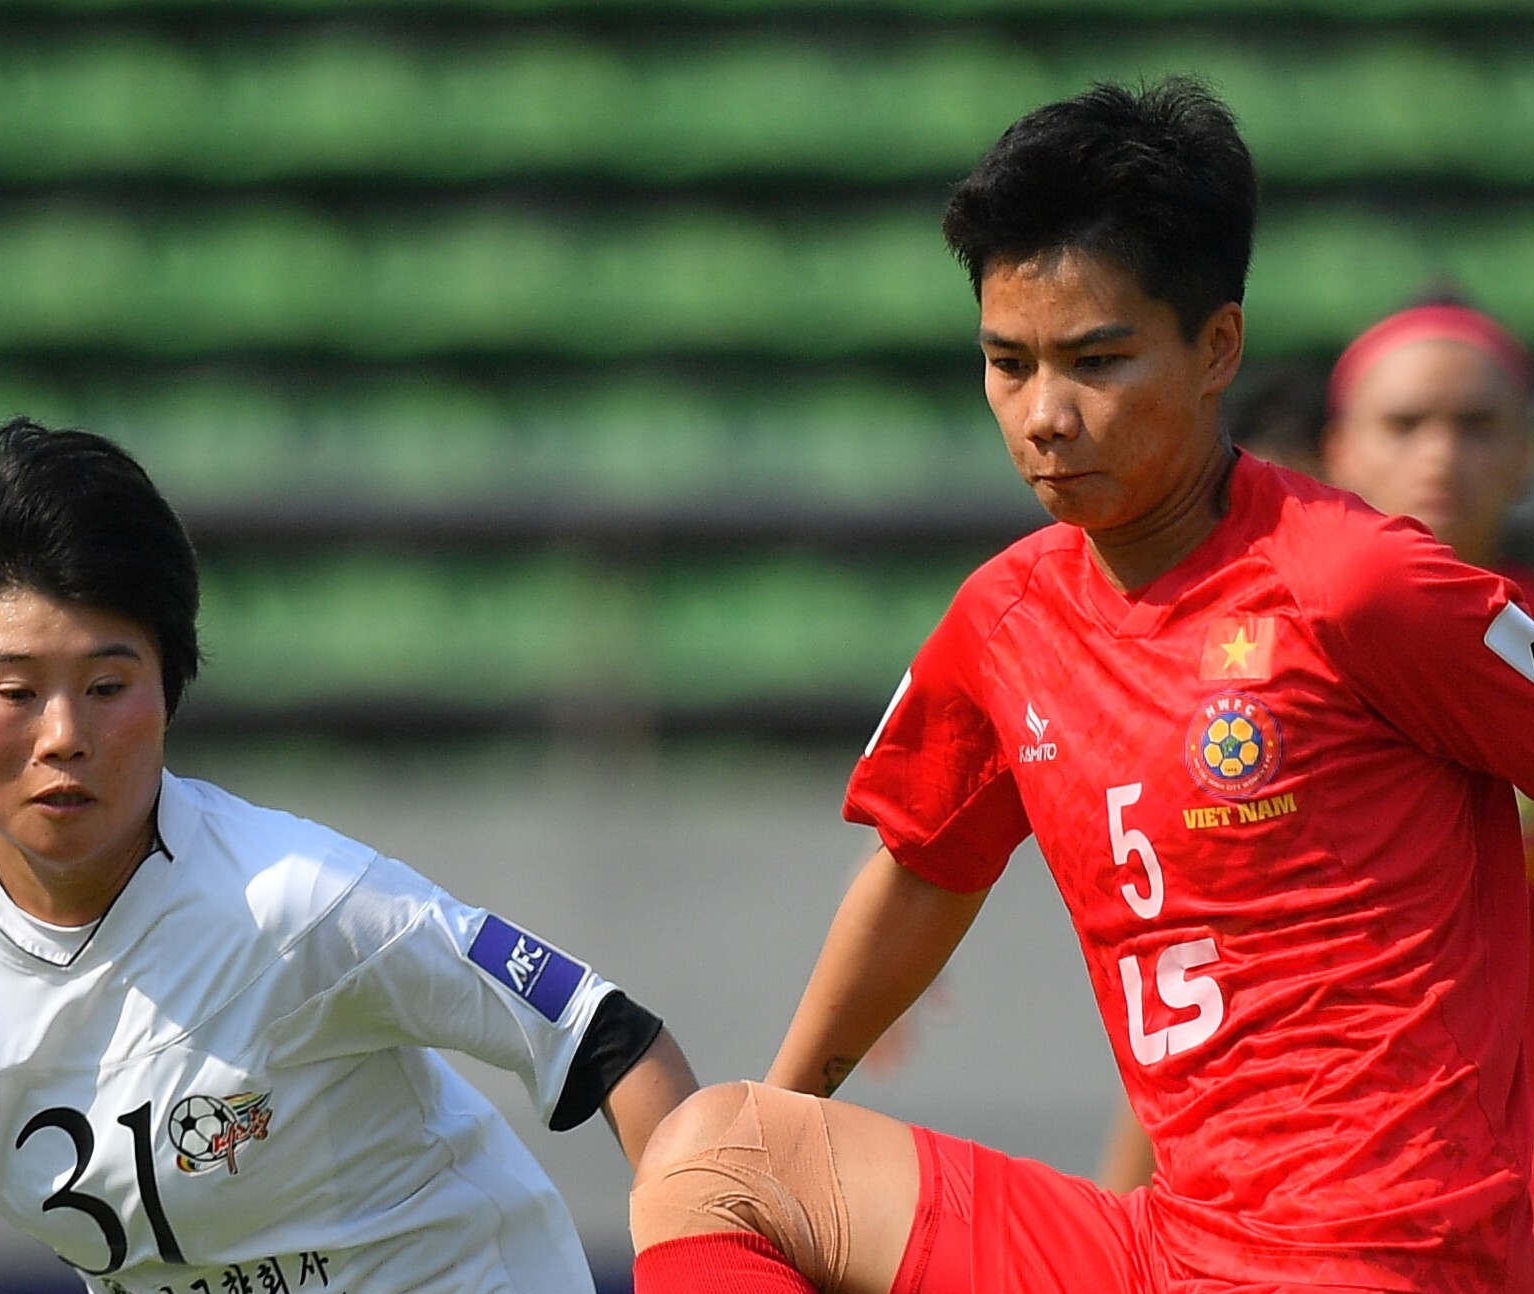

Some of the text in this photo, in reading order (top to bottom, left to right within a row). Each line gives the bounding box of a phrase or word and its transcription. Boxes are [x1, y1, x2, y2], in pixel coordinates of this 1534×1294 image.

[1206, 698, 1256, 719] HWFC
[1018, 743, 1057, 763] KAMITO
[1182, 793, 1297, 829] VIET NAM
[1106, 782, 1164, 919] 5
[506, 934, 543, 992] AFC
[1118, 938, 1224, 1066] LS
[16, 1100, 187, 1276] 31
